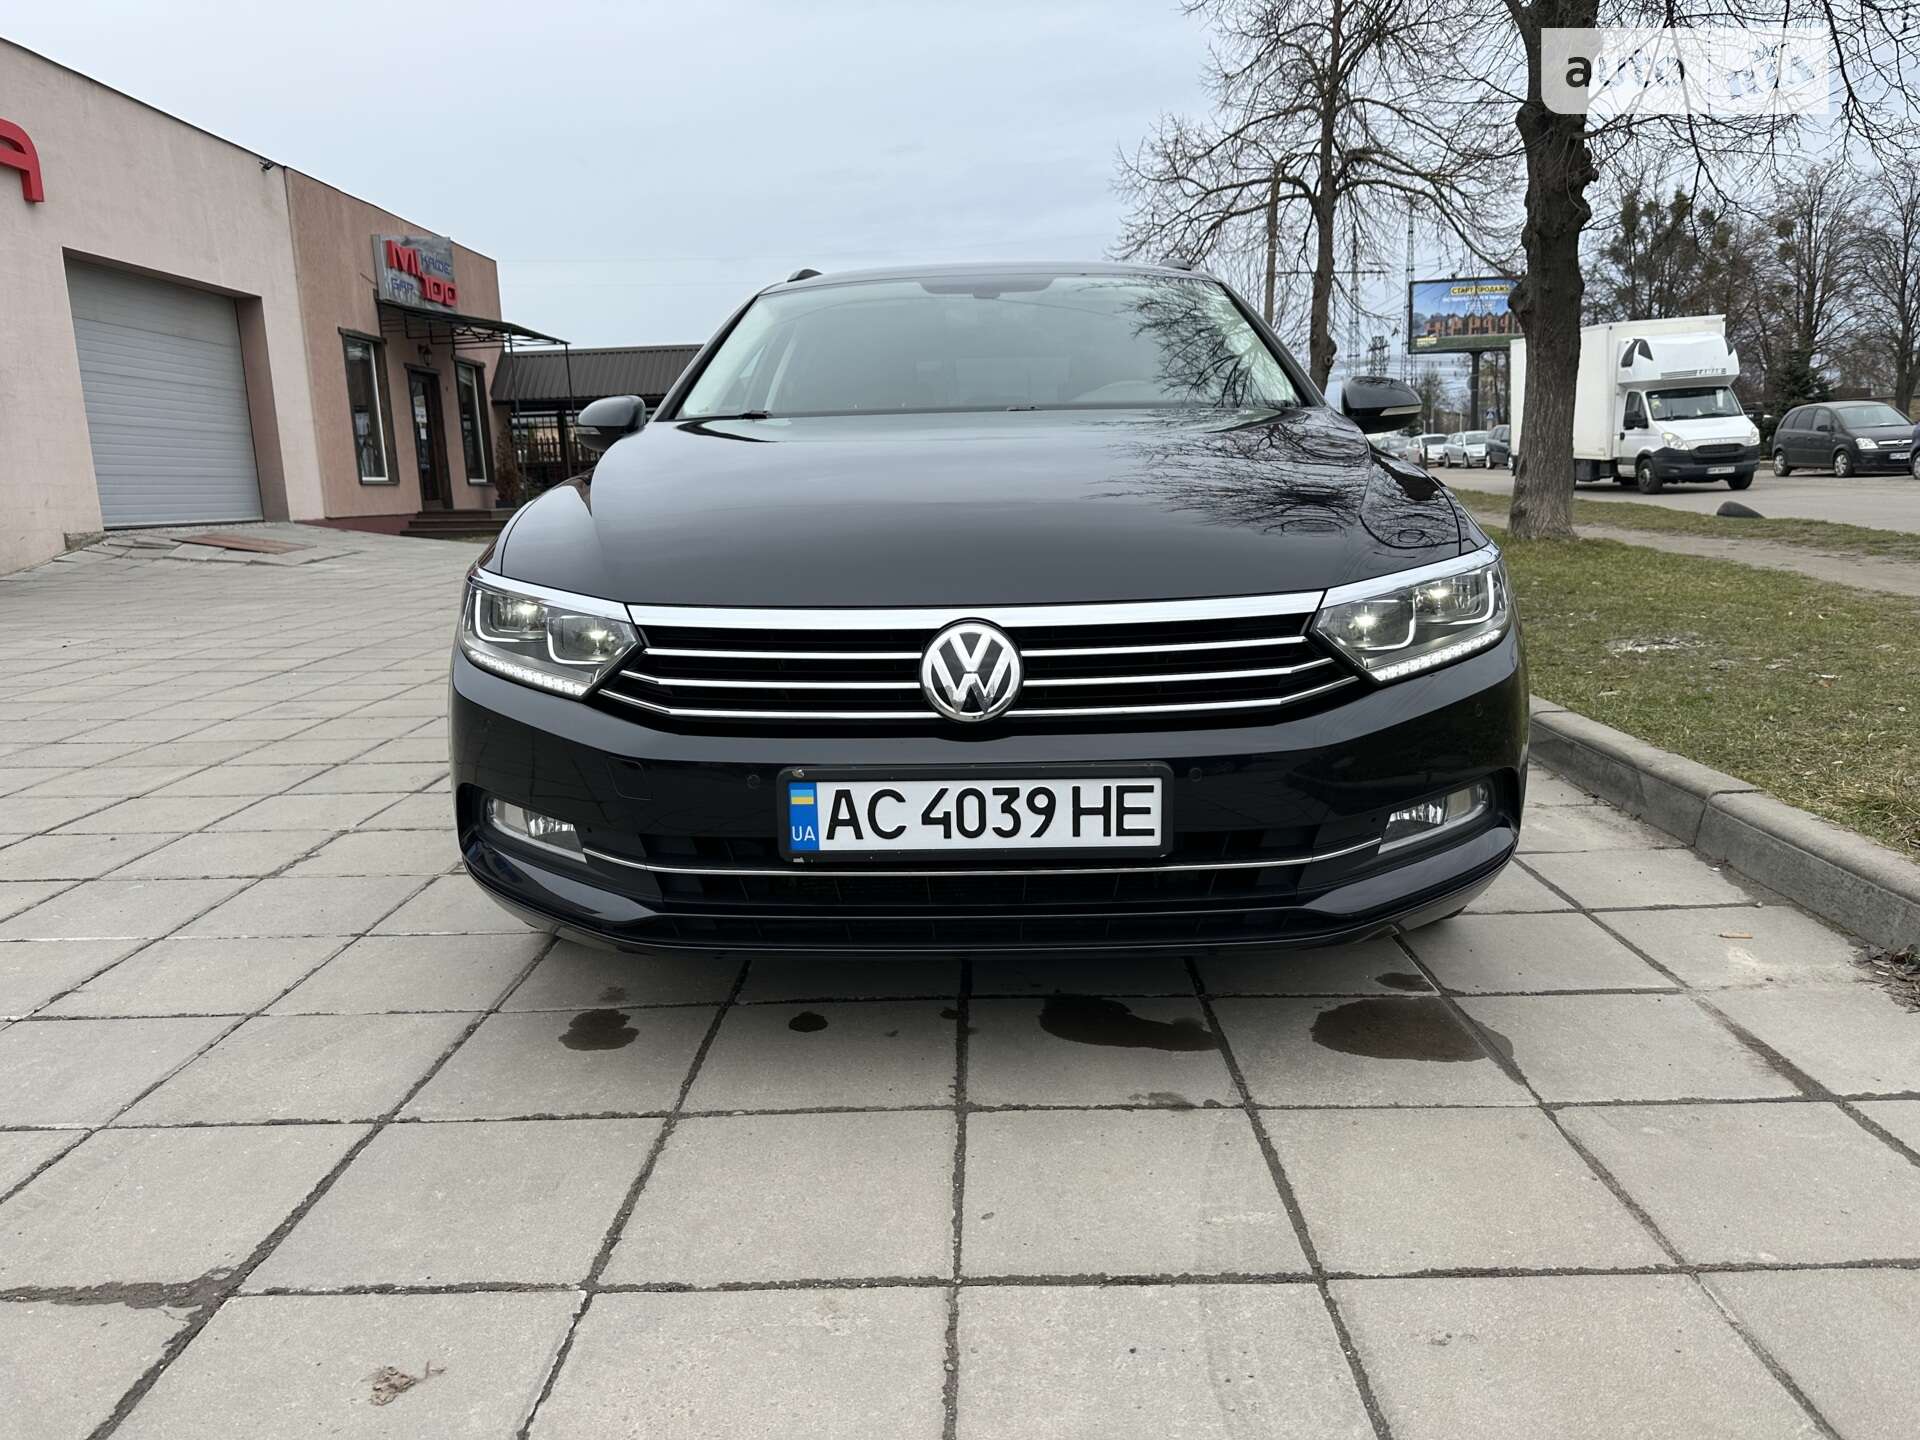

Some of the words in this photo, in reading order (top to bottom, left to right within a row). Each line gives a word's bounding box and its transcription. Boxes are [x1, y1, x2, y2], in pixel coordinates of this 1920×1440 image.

[825, 788, 907, 841] AC
[921, 786, 1057, 840] 4039
[1071, 784, 1155, 838] HE
[791, 825, 816, 842] UA
